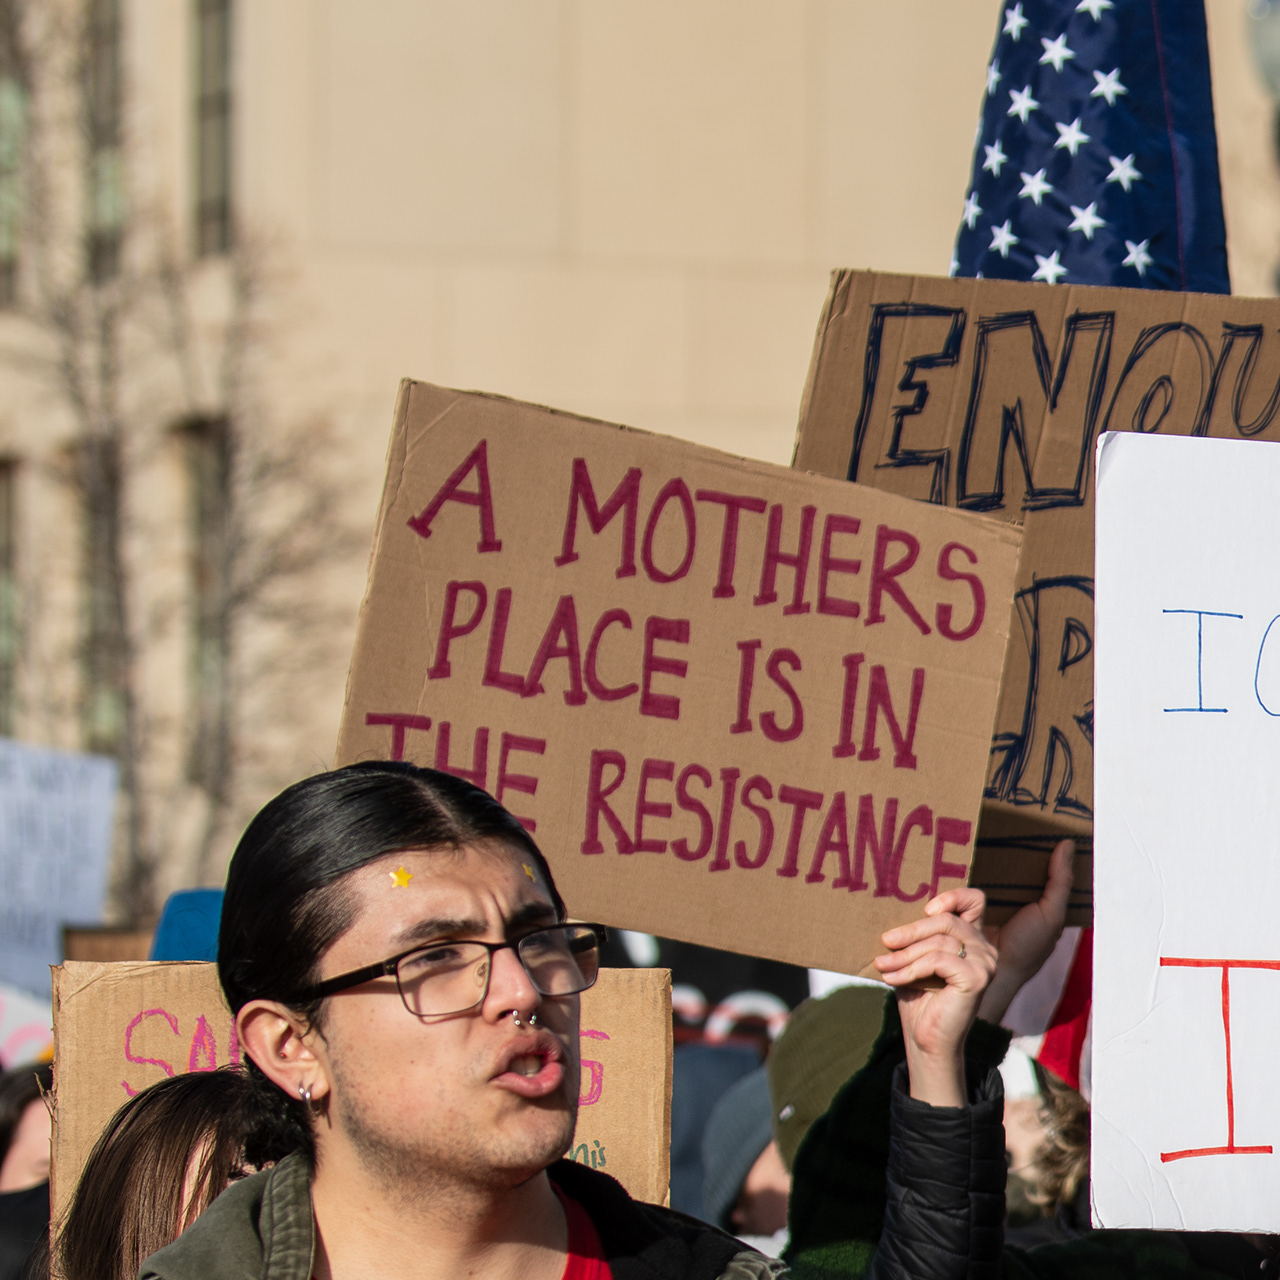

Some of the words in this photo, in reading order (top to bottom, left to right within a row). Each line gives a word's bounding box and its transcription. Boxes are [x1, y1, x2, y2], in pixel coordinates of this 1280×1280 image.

[406, 438, 502, 553] A
[553, 456, 986, 642] MOTHERS
[428, 580, 691, 721] PLACE
[729, 639, 803, 743] IS
[832, 652, 926, 770] IN
[580, 749, 972, 903] RESISTANCE
